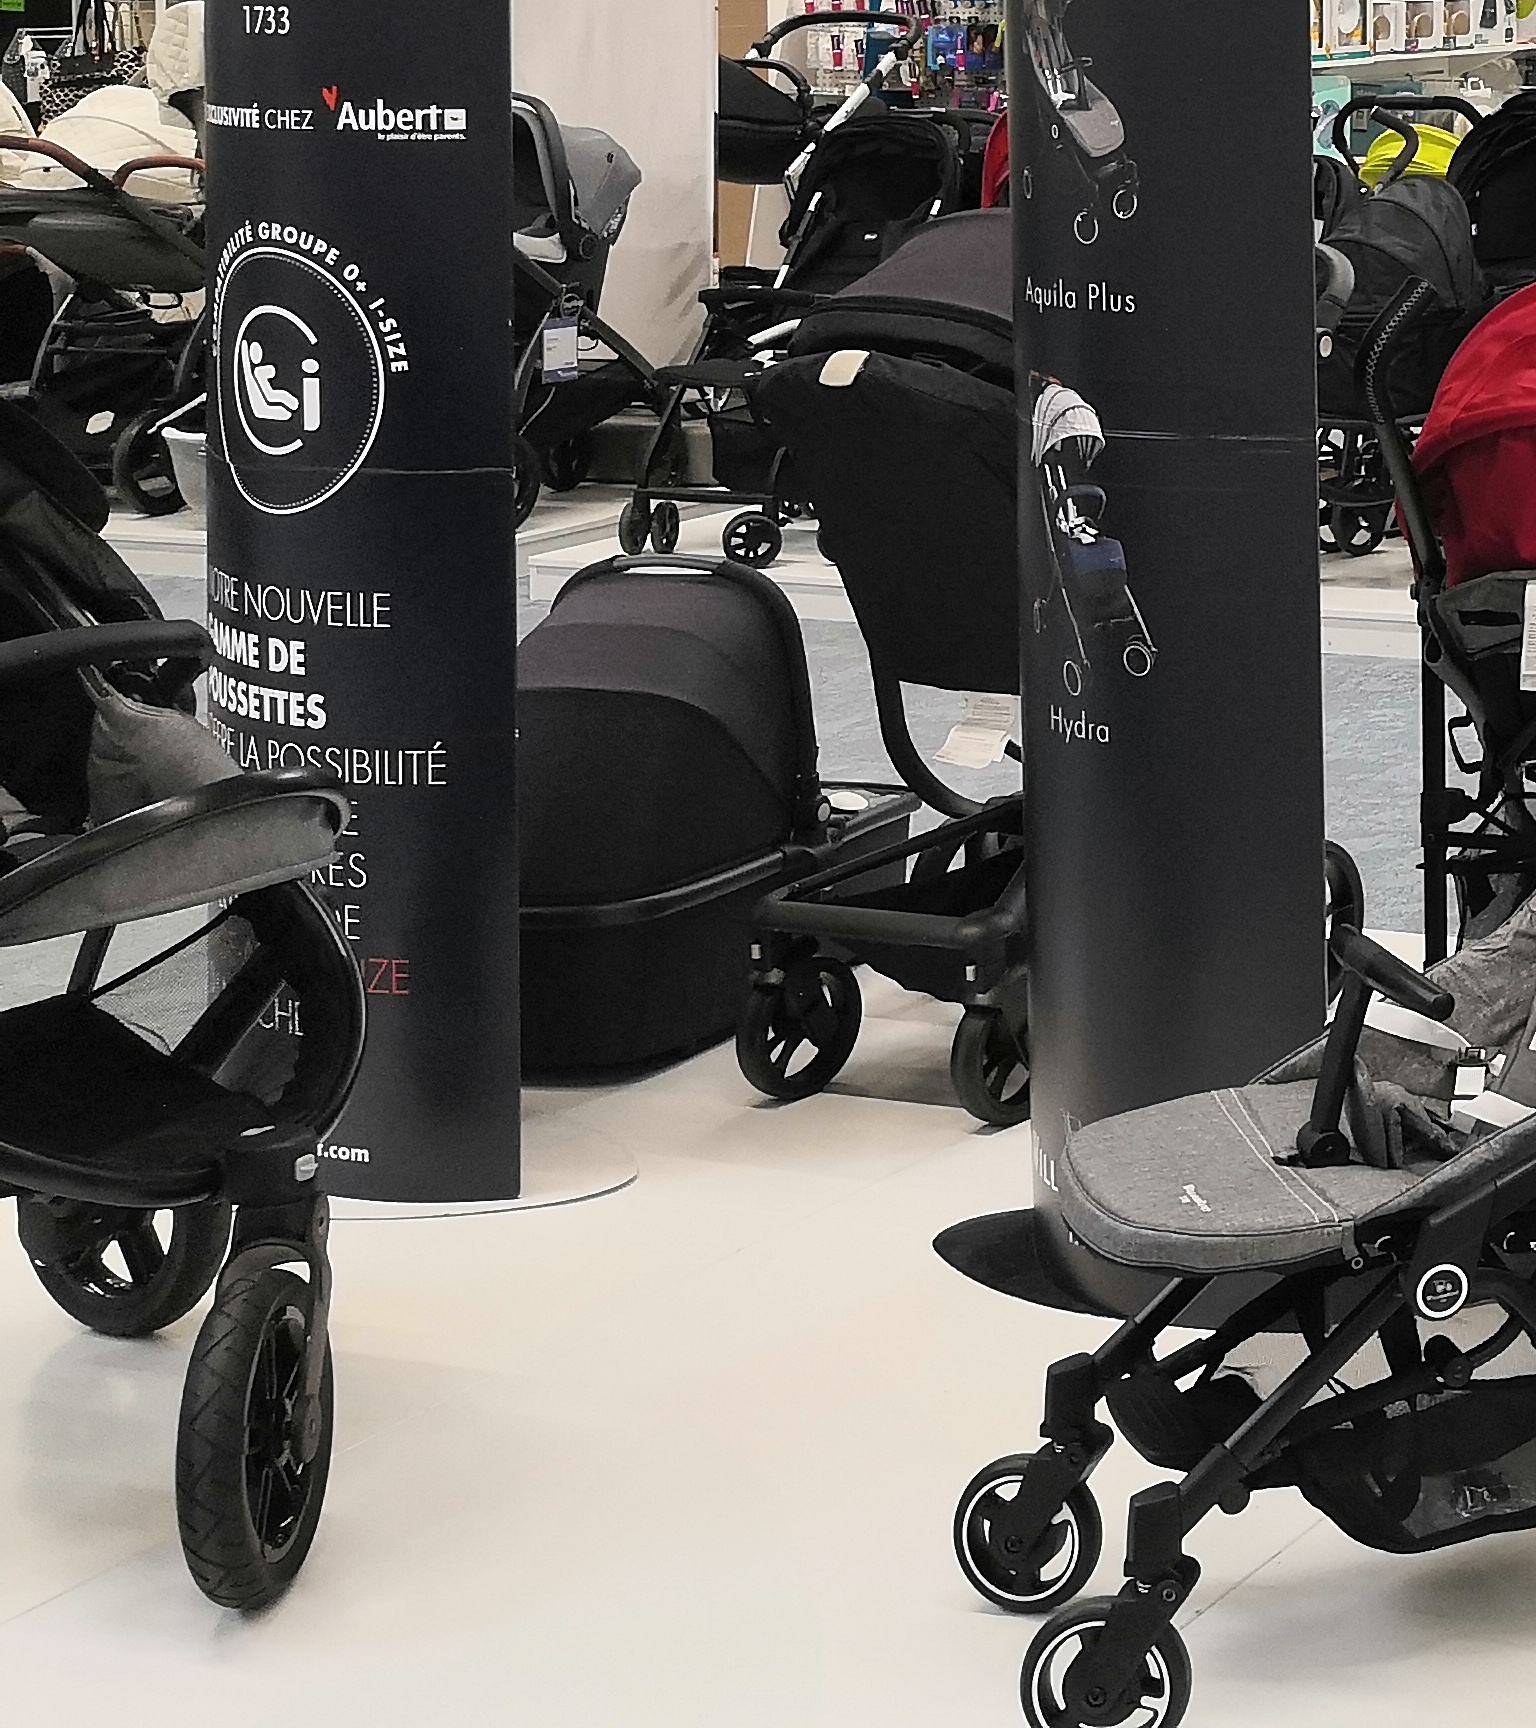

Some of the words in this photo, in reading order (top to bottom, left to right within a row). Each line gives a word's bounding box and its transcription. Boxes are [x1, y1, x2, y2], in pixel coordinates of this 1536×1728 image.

[242, 6, 290, 34] 1733
[265, 108, 314, 130] CHEZ
[336, 98, 444, 131] Aubert
[258, 221, 341, 266] GROUPE
[1024, 276, 1077, 313] Aquila
[1088, 281, 1137, 314] Plus
[244, 580, 392, 628] NOUVELLE
[268, 637, 306, 675] DE
[1050, 707, 1111, 745] Hydra
[239, 732, 261, 771] LA
[268, 740, 447, 786] POSSIBILITÉ
